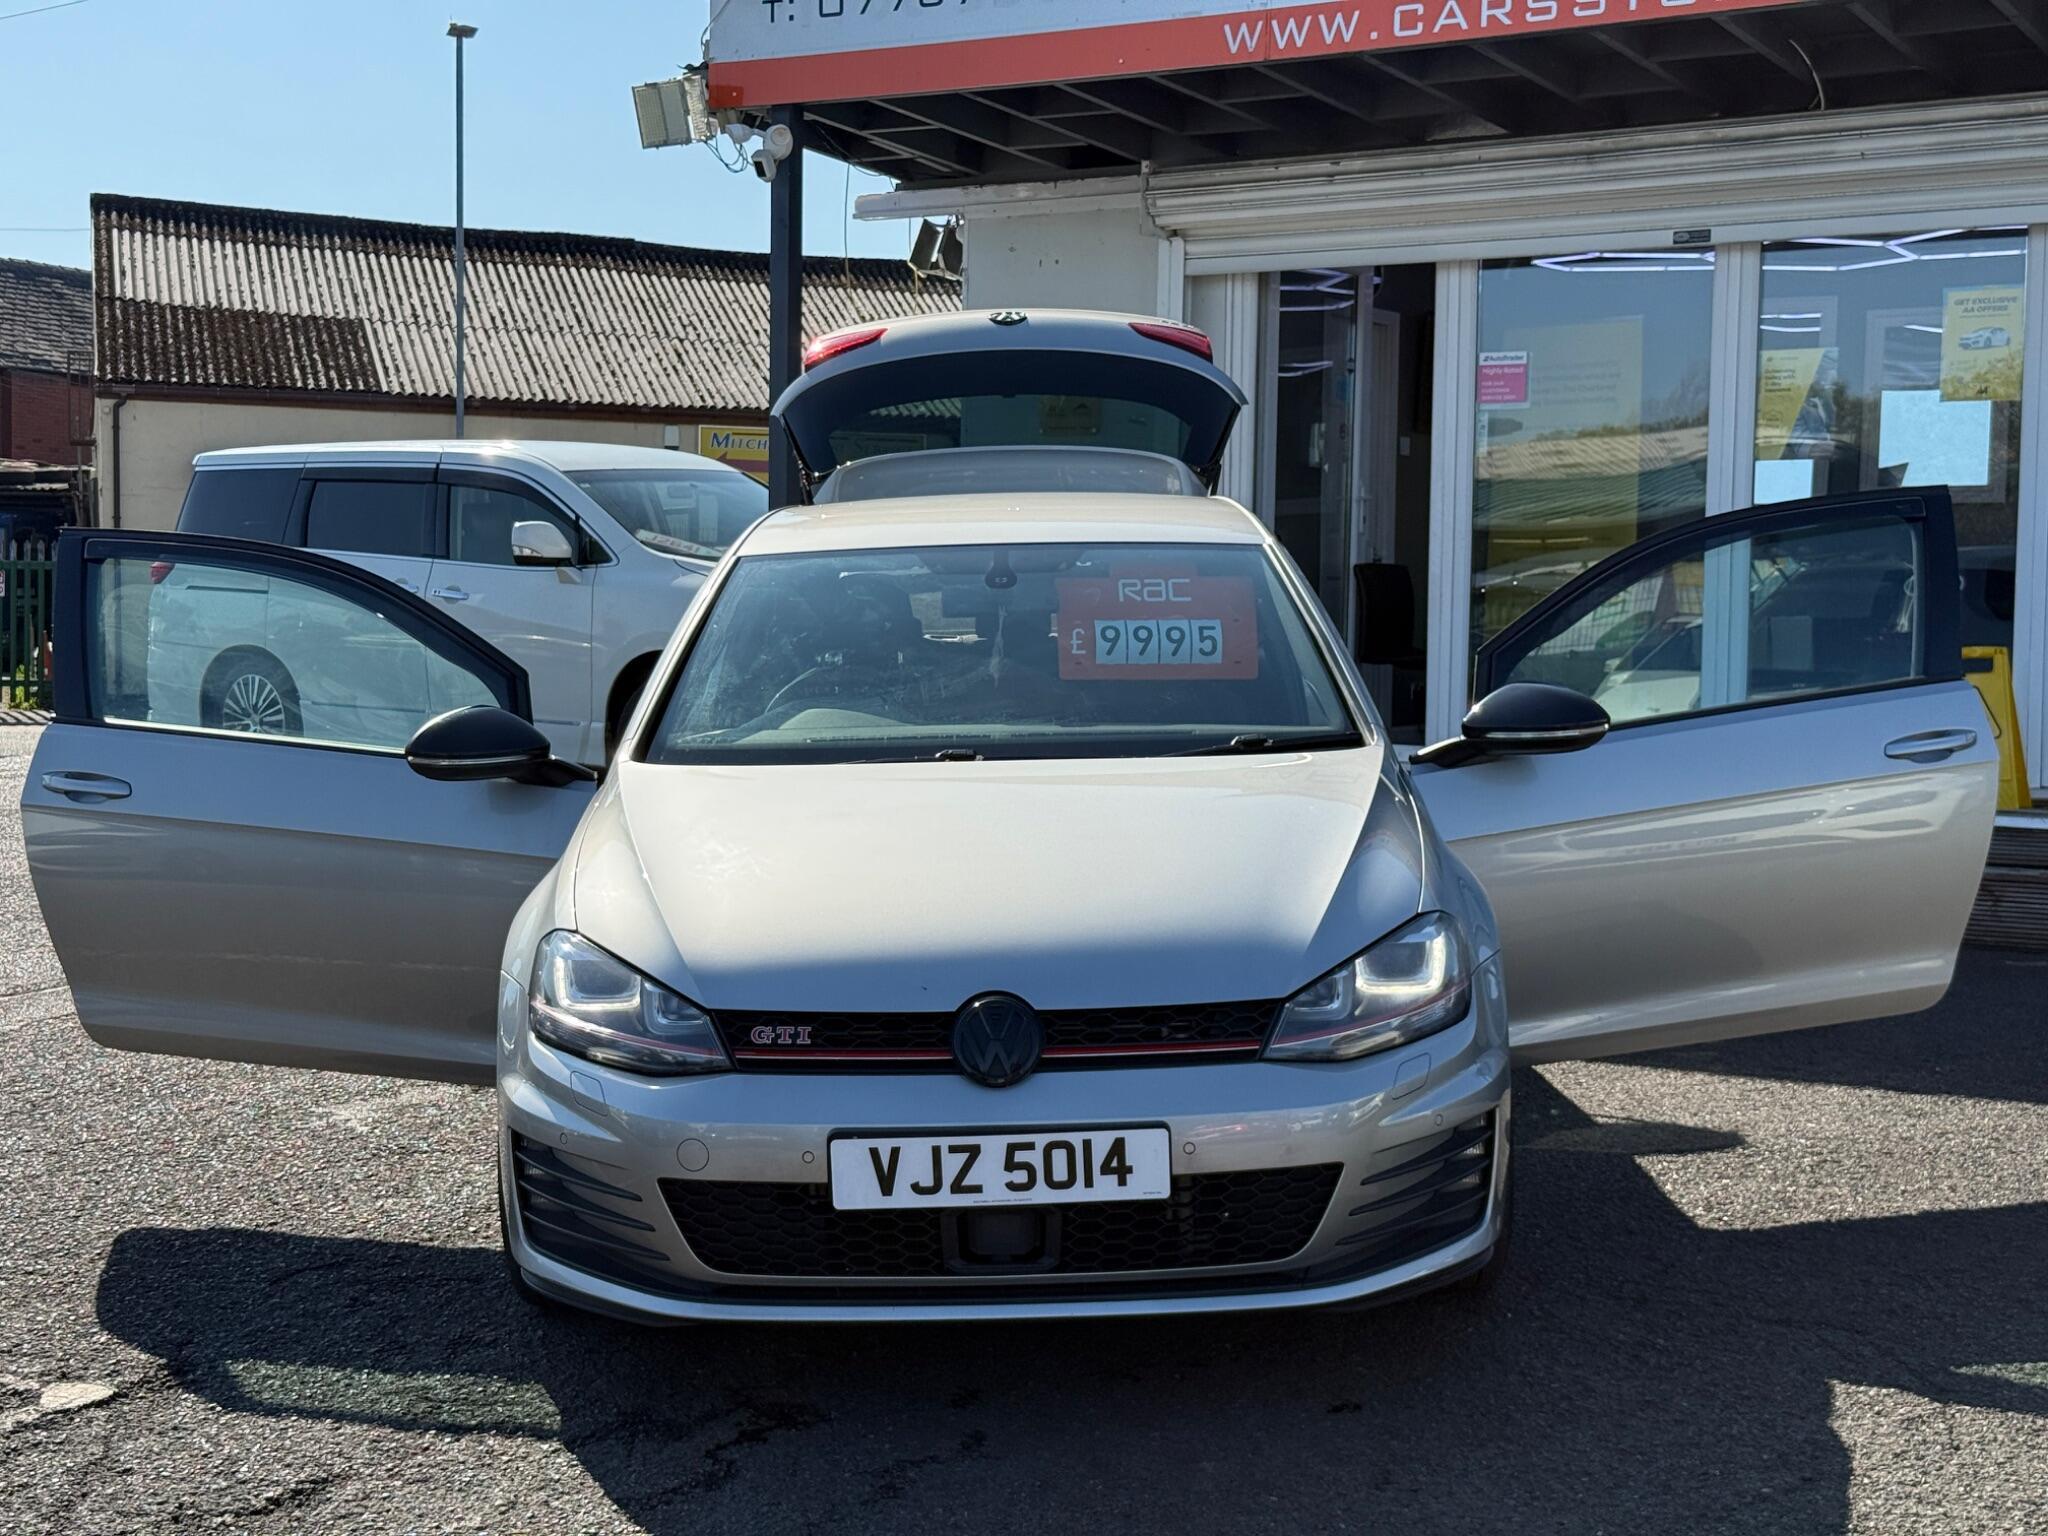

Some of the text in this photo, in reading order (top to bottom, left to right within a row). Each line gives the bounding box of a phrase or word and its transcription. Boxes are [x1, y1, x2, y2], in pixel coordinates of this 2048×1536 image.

[1972, 296, 2018, 305] EXCLUSIVE
[1976, 305, 2009, 313] OFFERS
[1070, 625, 1218, 657] £ 9995
[751, 1026, 812, 1045] GTI
[868, 1136, 1134, 1197] VJZ 5014
